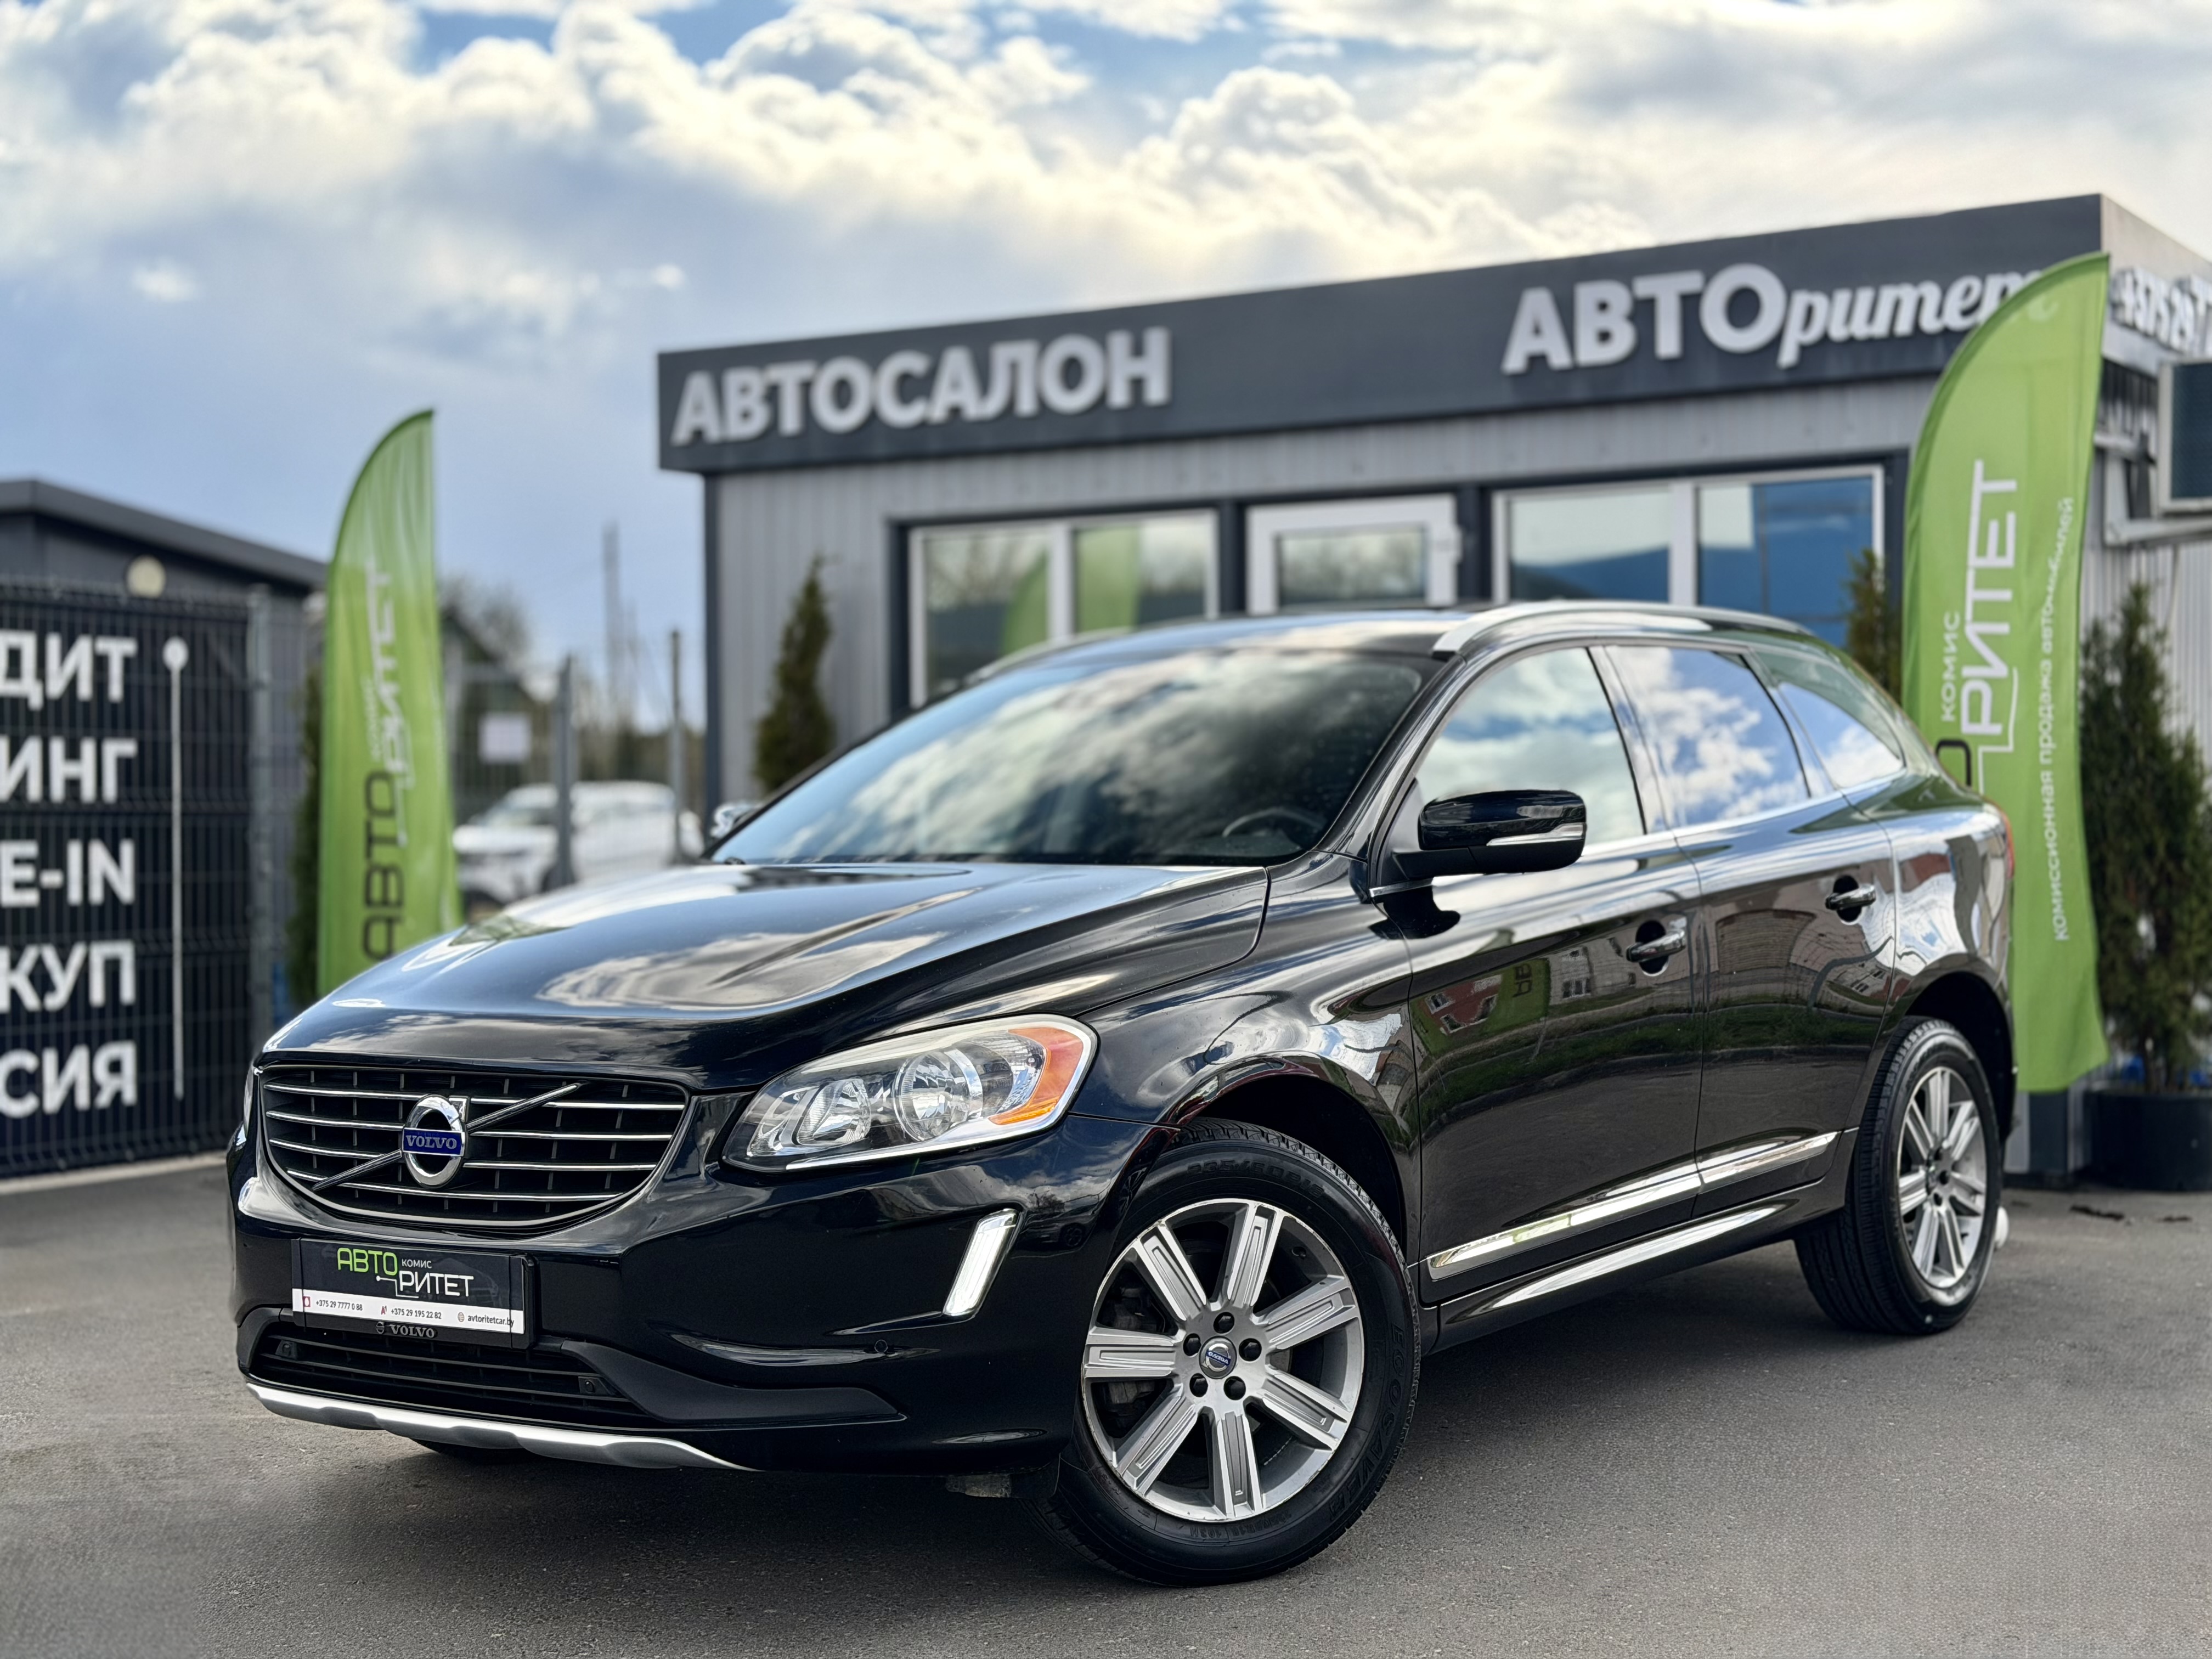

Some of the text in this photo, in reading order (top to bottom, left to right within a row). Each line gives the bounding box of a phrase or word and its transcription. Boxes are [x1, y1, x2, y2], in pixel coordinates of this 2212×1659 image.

[671, 327, 1171, 446] АВТОСАЛОН
[1961, 459, 2017, 735] РИТЕТ
[0, 629, 138, 711] ДИТ
[2039, 659, 2056, 765] продажа
[0, 734, 138, 803] ИНГ
[0, 838, 136, 907] E-IN
[362, 771, 404, 962] АВТО
[0, 939, 136, 1013] КУП
[0, 1040, 138, 1119] СИЯ
[405, 1135, 457, 1149] VOLVO
[337, 1247, 398, 1276] АВТО
[399, 1269, 474, 1297] РИТЕТ
[316, 1299, 329, 1308] +375
[337, 1301, 351, 1310] 7777
[390, 1324, 435, 1338] VOLVO
[391, 1307, 405, 1316] +375
[414, 1310, 425, 1318] 195
[434, 1311, 442, 1319] 82
[467, 1314, 515, 1328] avtoritetcar.by
[1207, 1351, 1229, 1364] VOLVO
